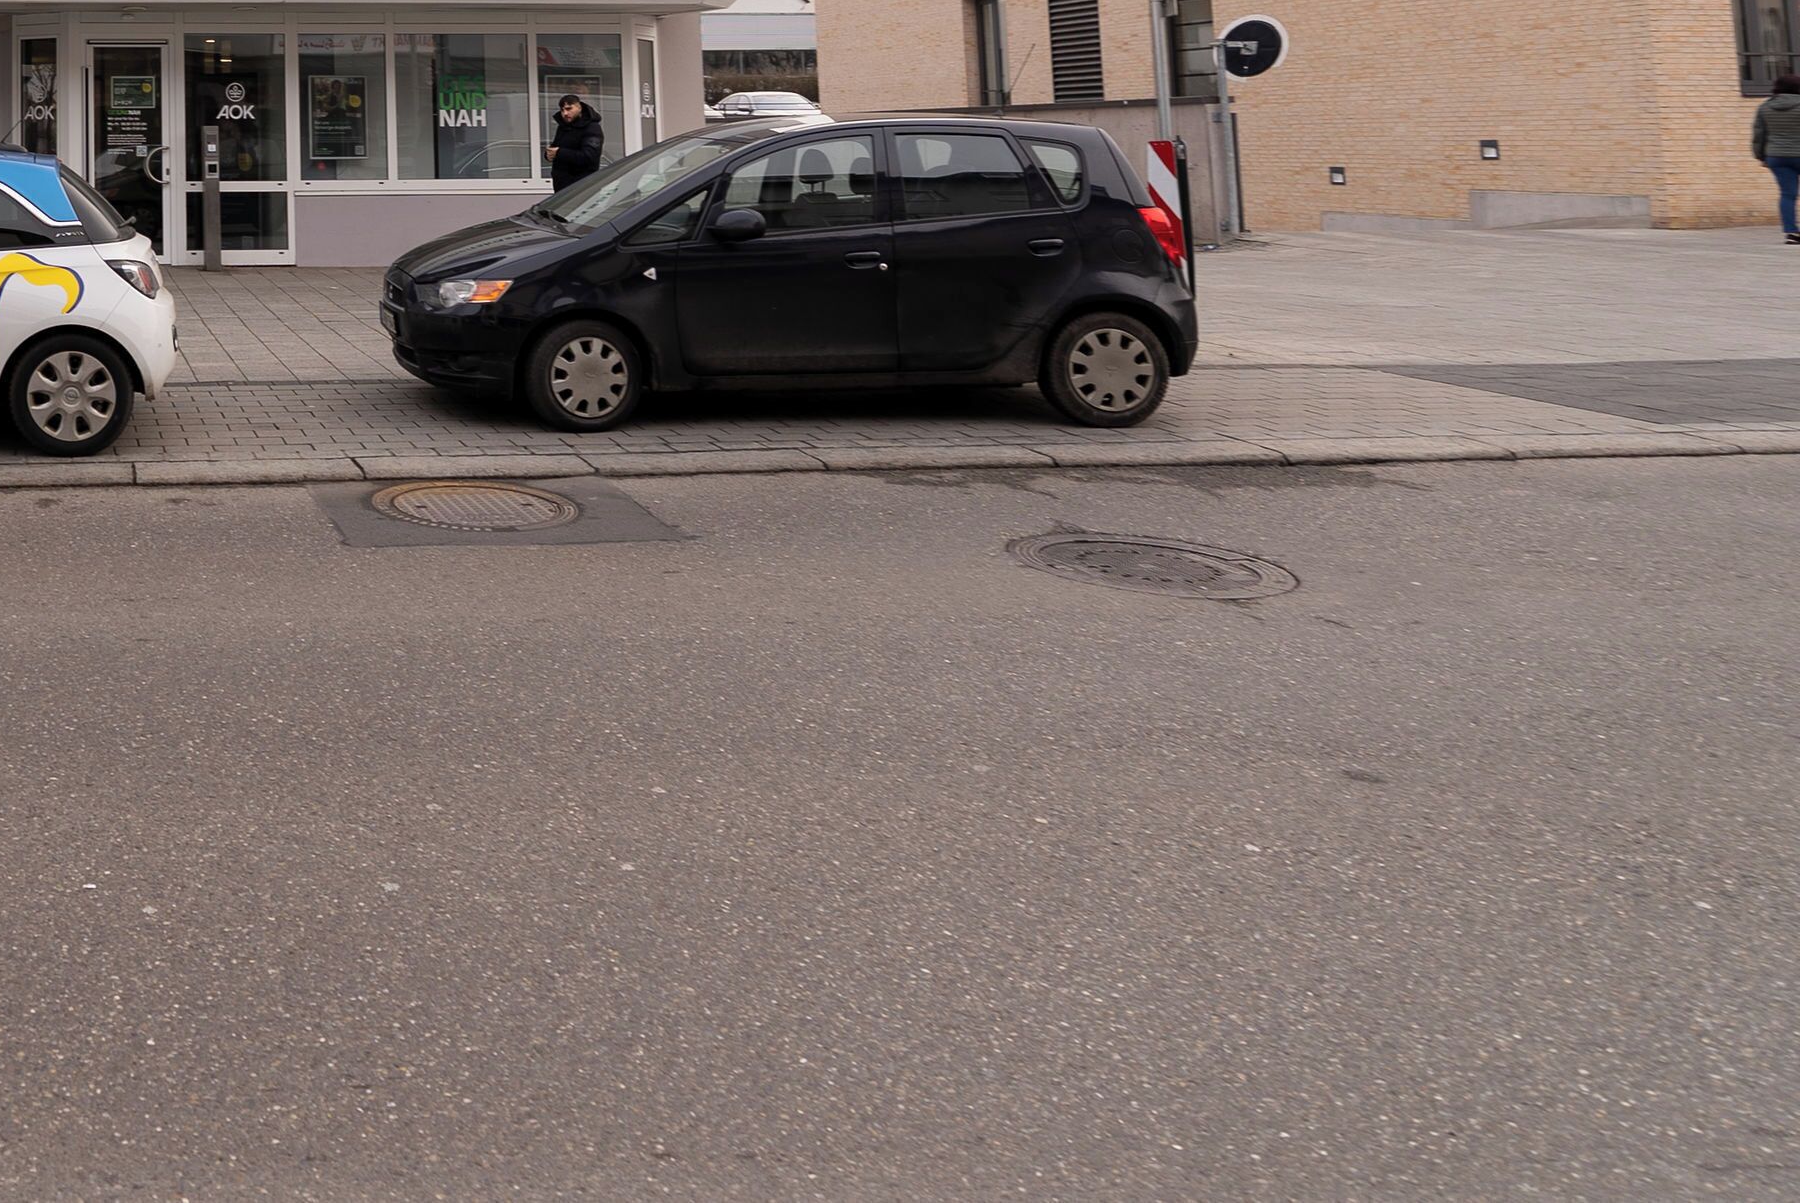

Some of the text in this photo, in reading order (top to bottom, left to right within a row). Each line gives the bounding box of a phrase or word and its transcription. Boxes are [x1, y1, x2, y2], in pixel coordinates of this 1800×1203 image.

[439, 93, 488, 110] UND
[24, 105, 55, 120] AOK
[216, 104, 256, 120] AOK
[439, 109, 487, 127] NAH
